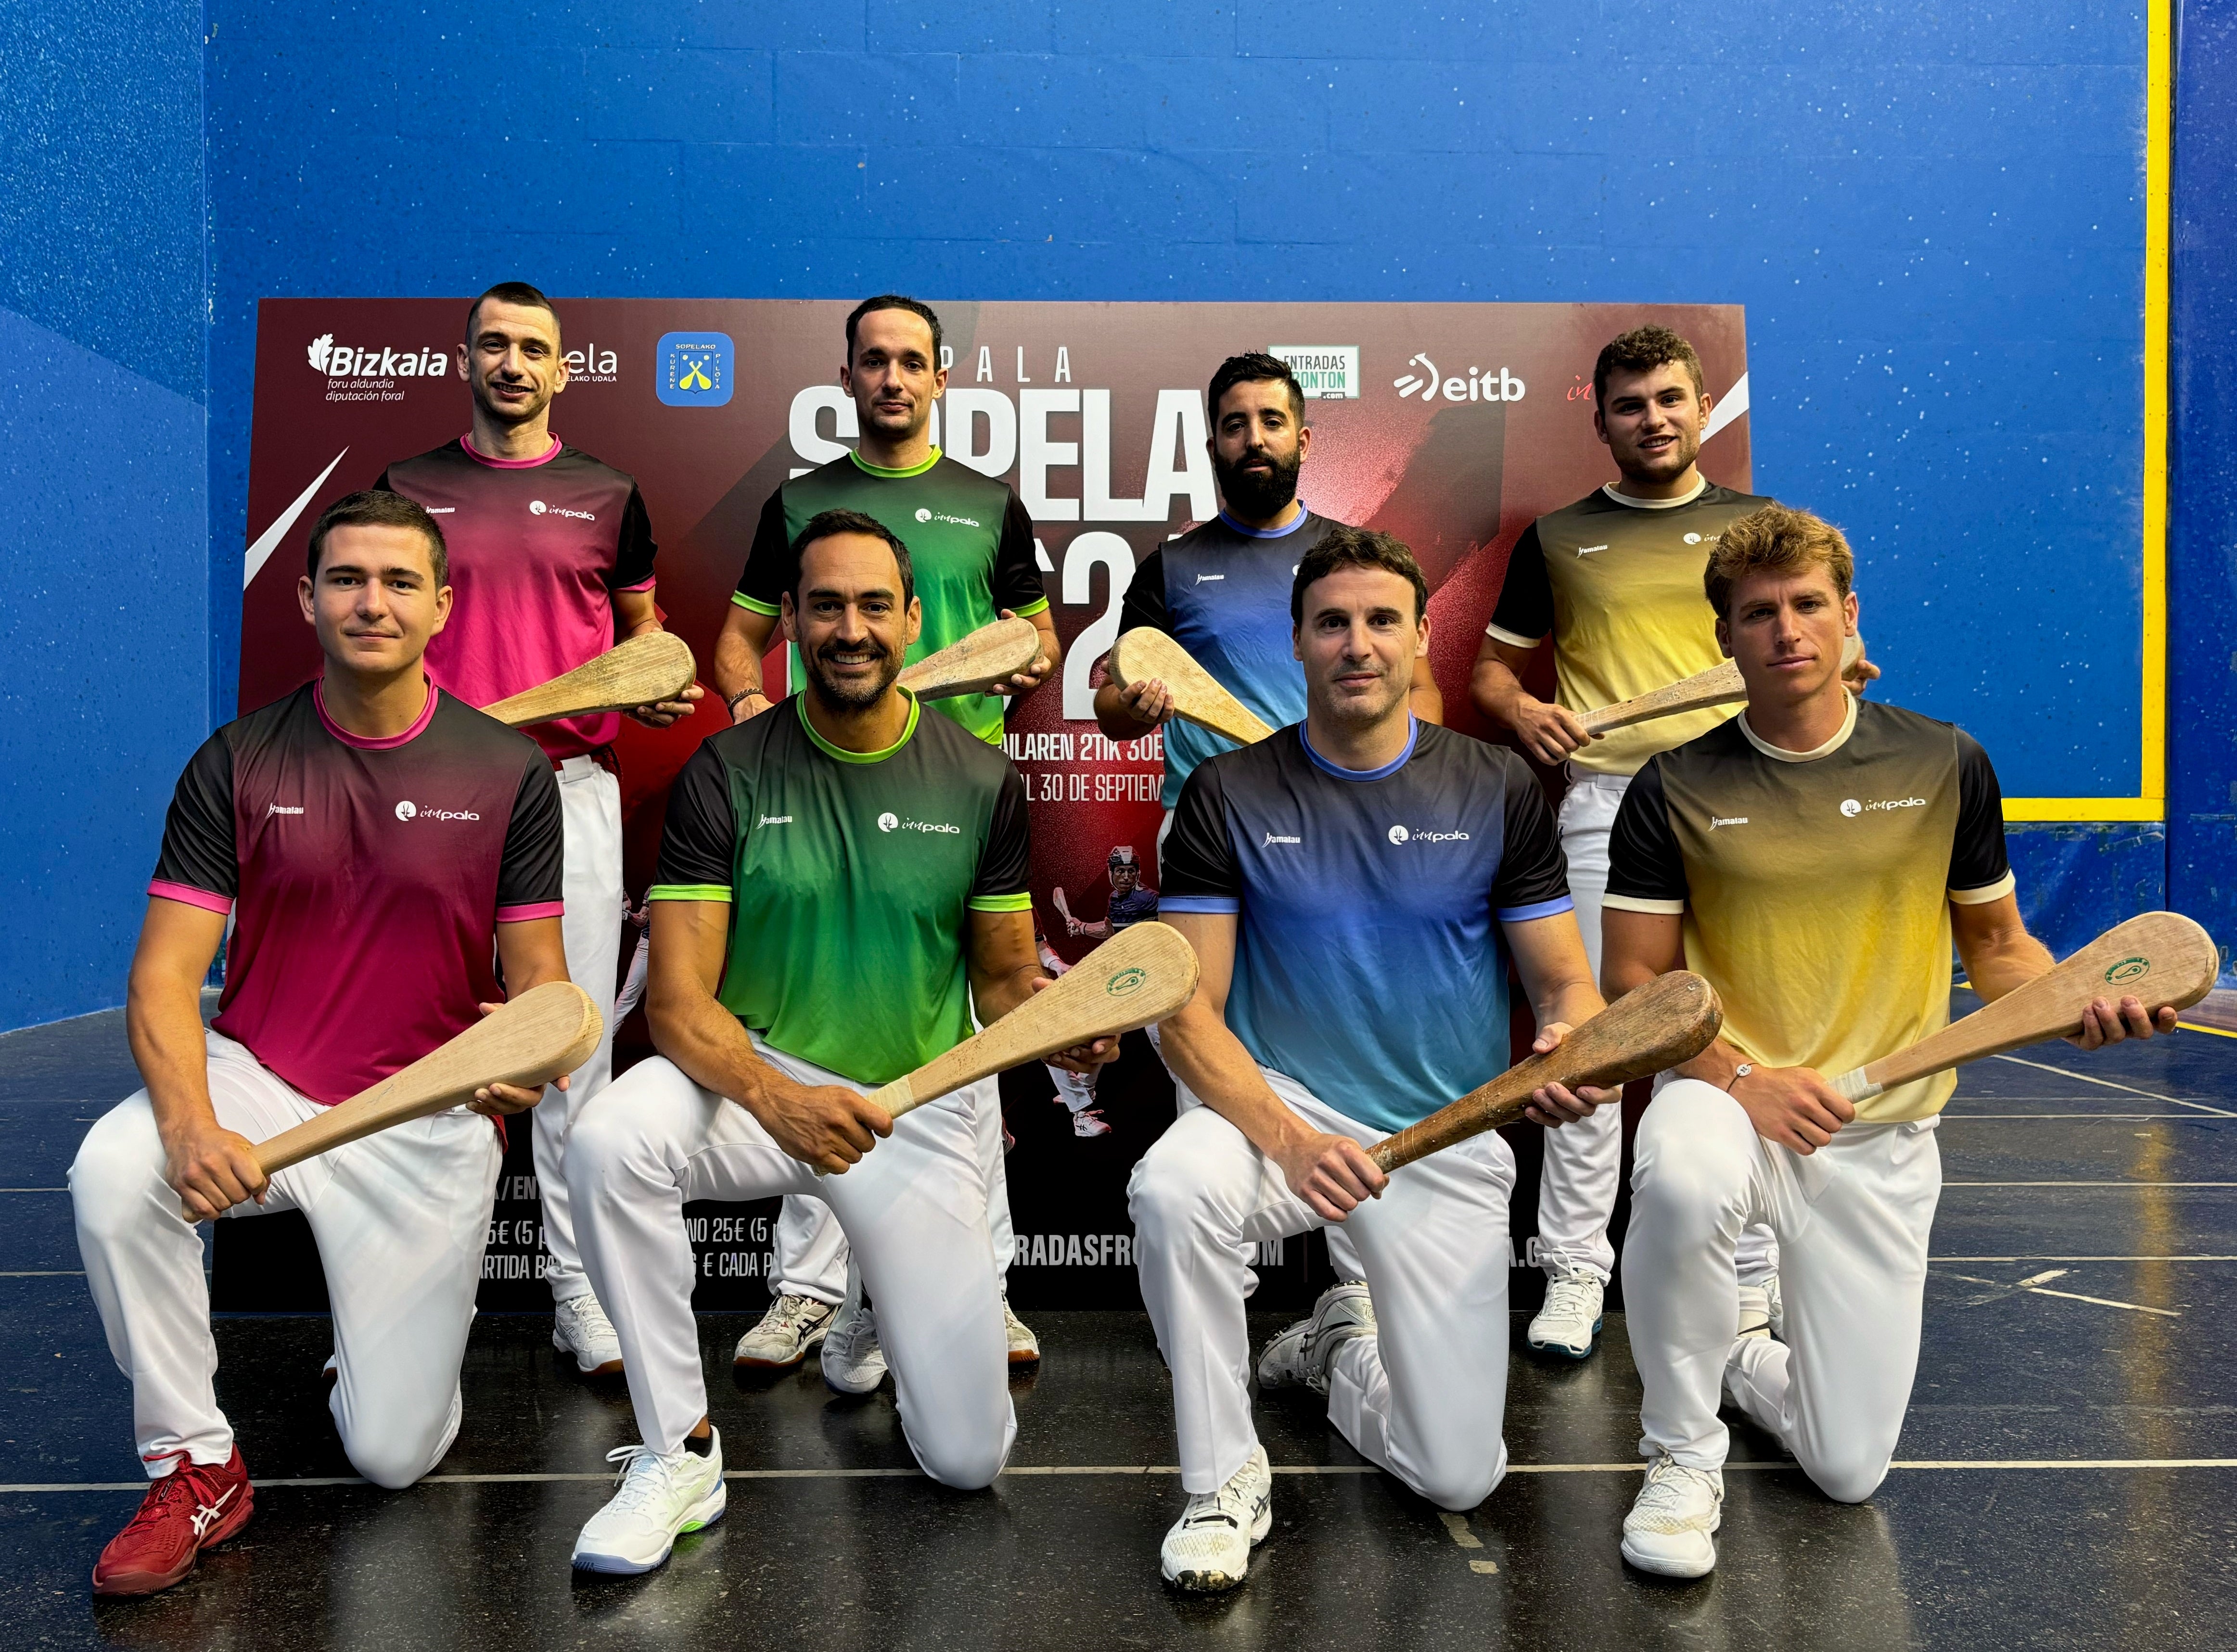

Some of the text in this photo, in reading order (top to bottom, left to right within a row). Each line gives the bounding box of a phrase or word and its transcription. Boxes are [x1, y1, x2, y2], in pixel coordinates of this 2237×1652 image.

[329, 347, 448, 376] Bizkaia
[564, 343, 617, 374] ela
[327, 378, 394, 390] foru aldundia
[1292, 371, 1345, 388] RONTON
[1443, 366, 1525, 401] eitb
[326, 391, 405, 402] diputación foral
[788, 385, 1220, 522] SPELA
[999, 733, 1164, 761] AILAREN 2TIK 30E
[1040, 774, 1063, 801] 30
[1069, 774, 1090, 801] DE
[1095, 774, 1165, 801] SEPTIEM
[515, 1220, 533, 1244] (5
[687, 1218, 707, 1242] NO
[713, 1217, 745, 1242] 25€
[750, 1218, 767, 1242] (5
[1013, 1234, 1138, 1266] RADASFR
[719, 1252, 758, 1277] CADA
